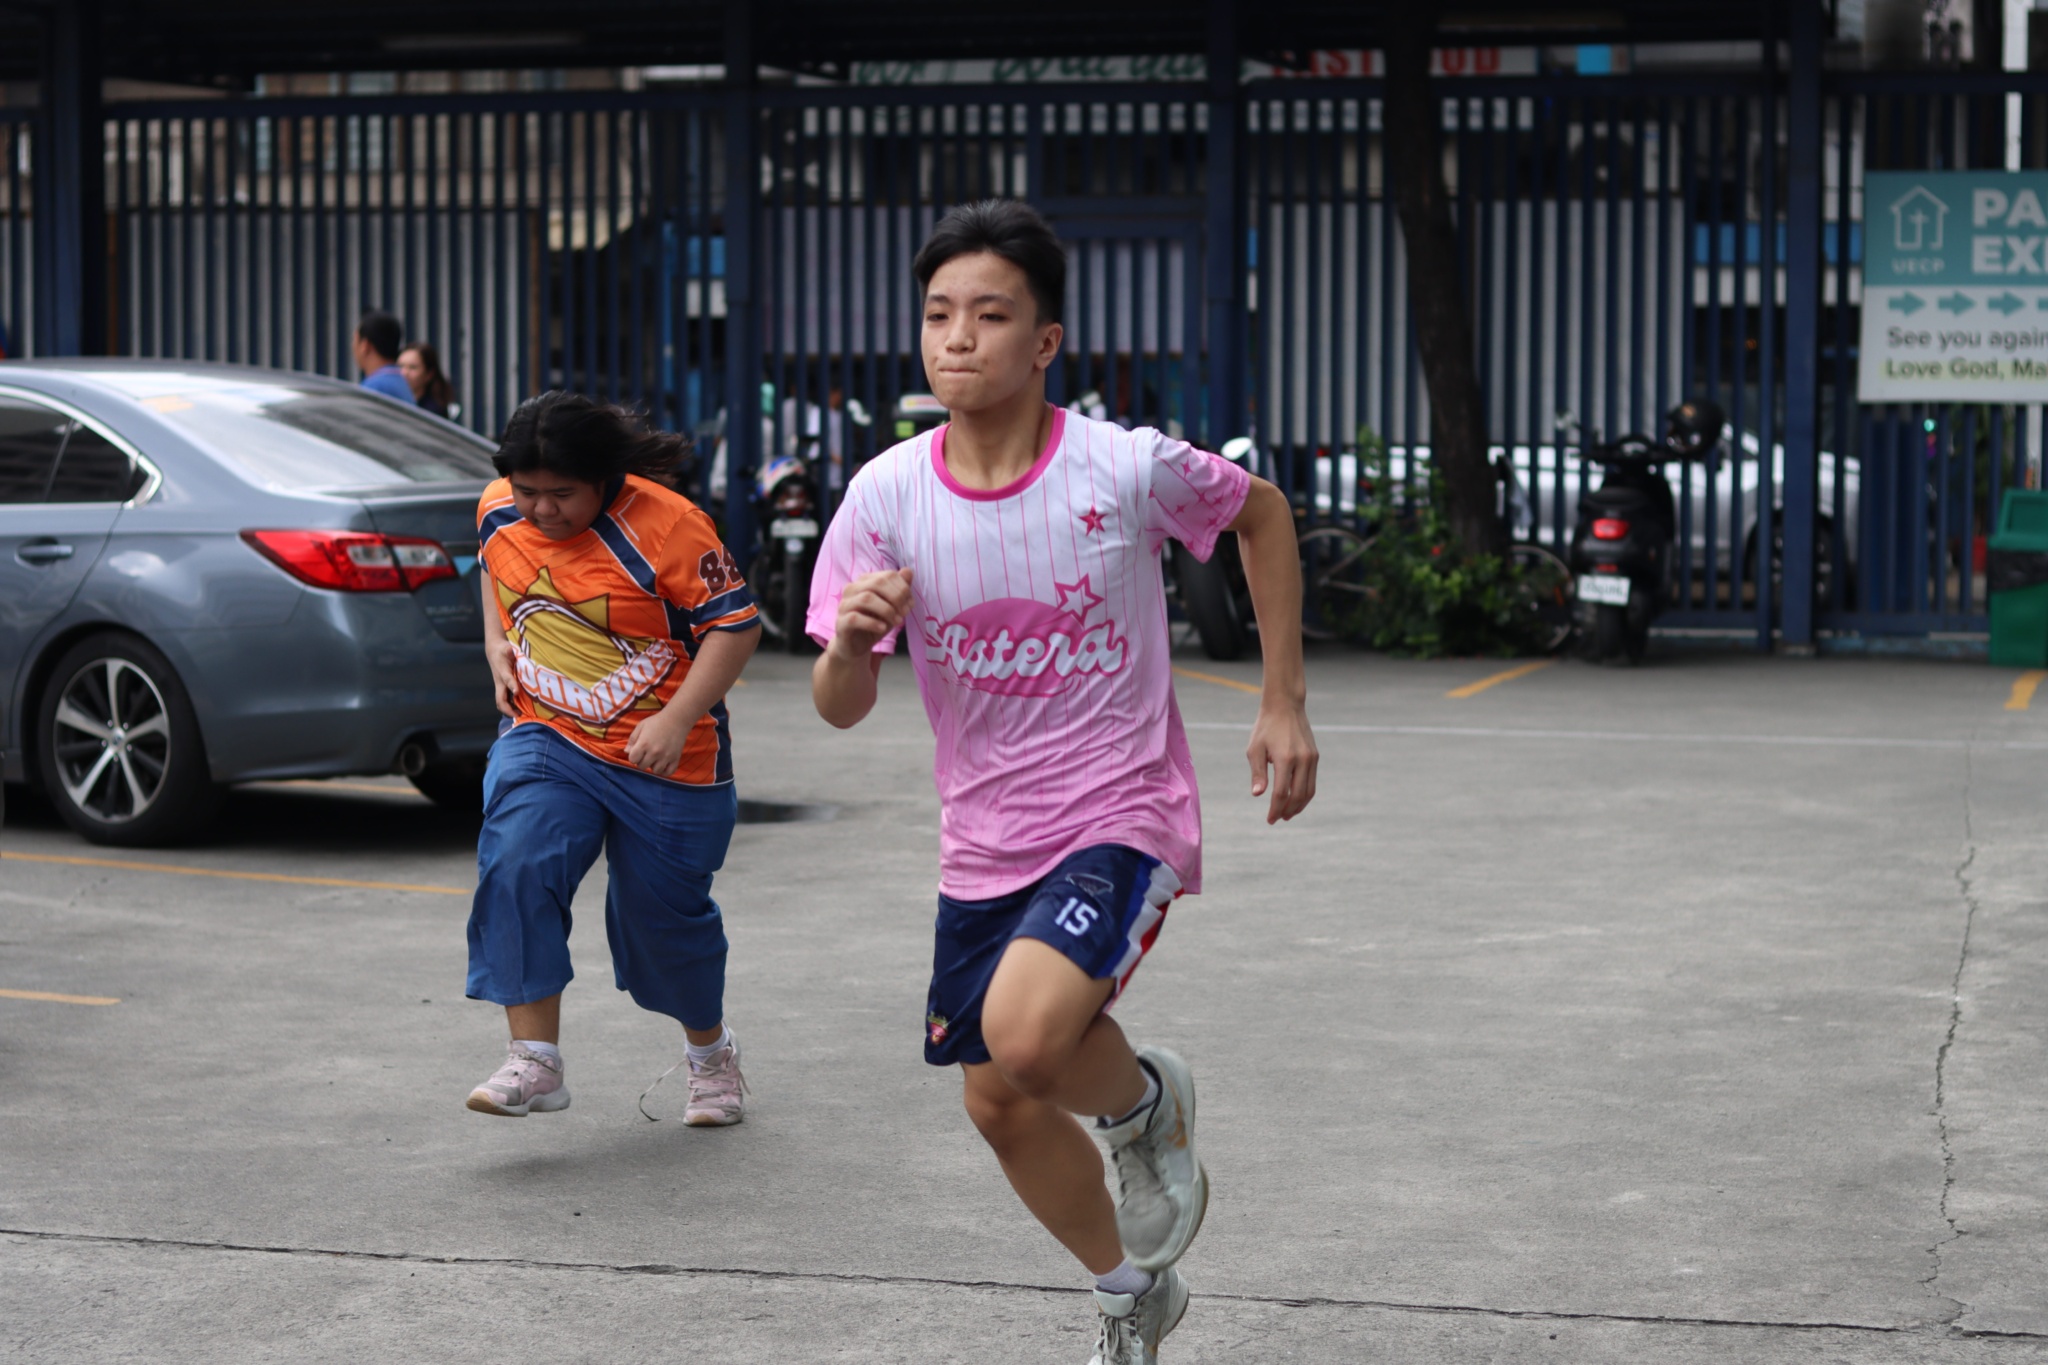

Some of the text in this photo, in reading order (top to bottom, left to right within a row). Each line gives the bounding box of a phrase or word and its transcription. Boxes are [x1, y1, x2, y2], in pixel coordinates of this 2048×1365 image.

[1892, 258, 1945, 274] UECP
[1887, 326, 1932, 349] See
[1939, 331, 1982, 353] you
[1886, 357, 2048, 381] Love God, Ma
